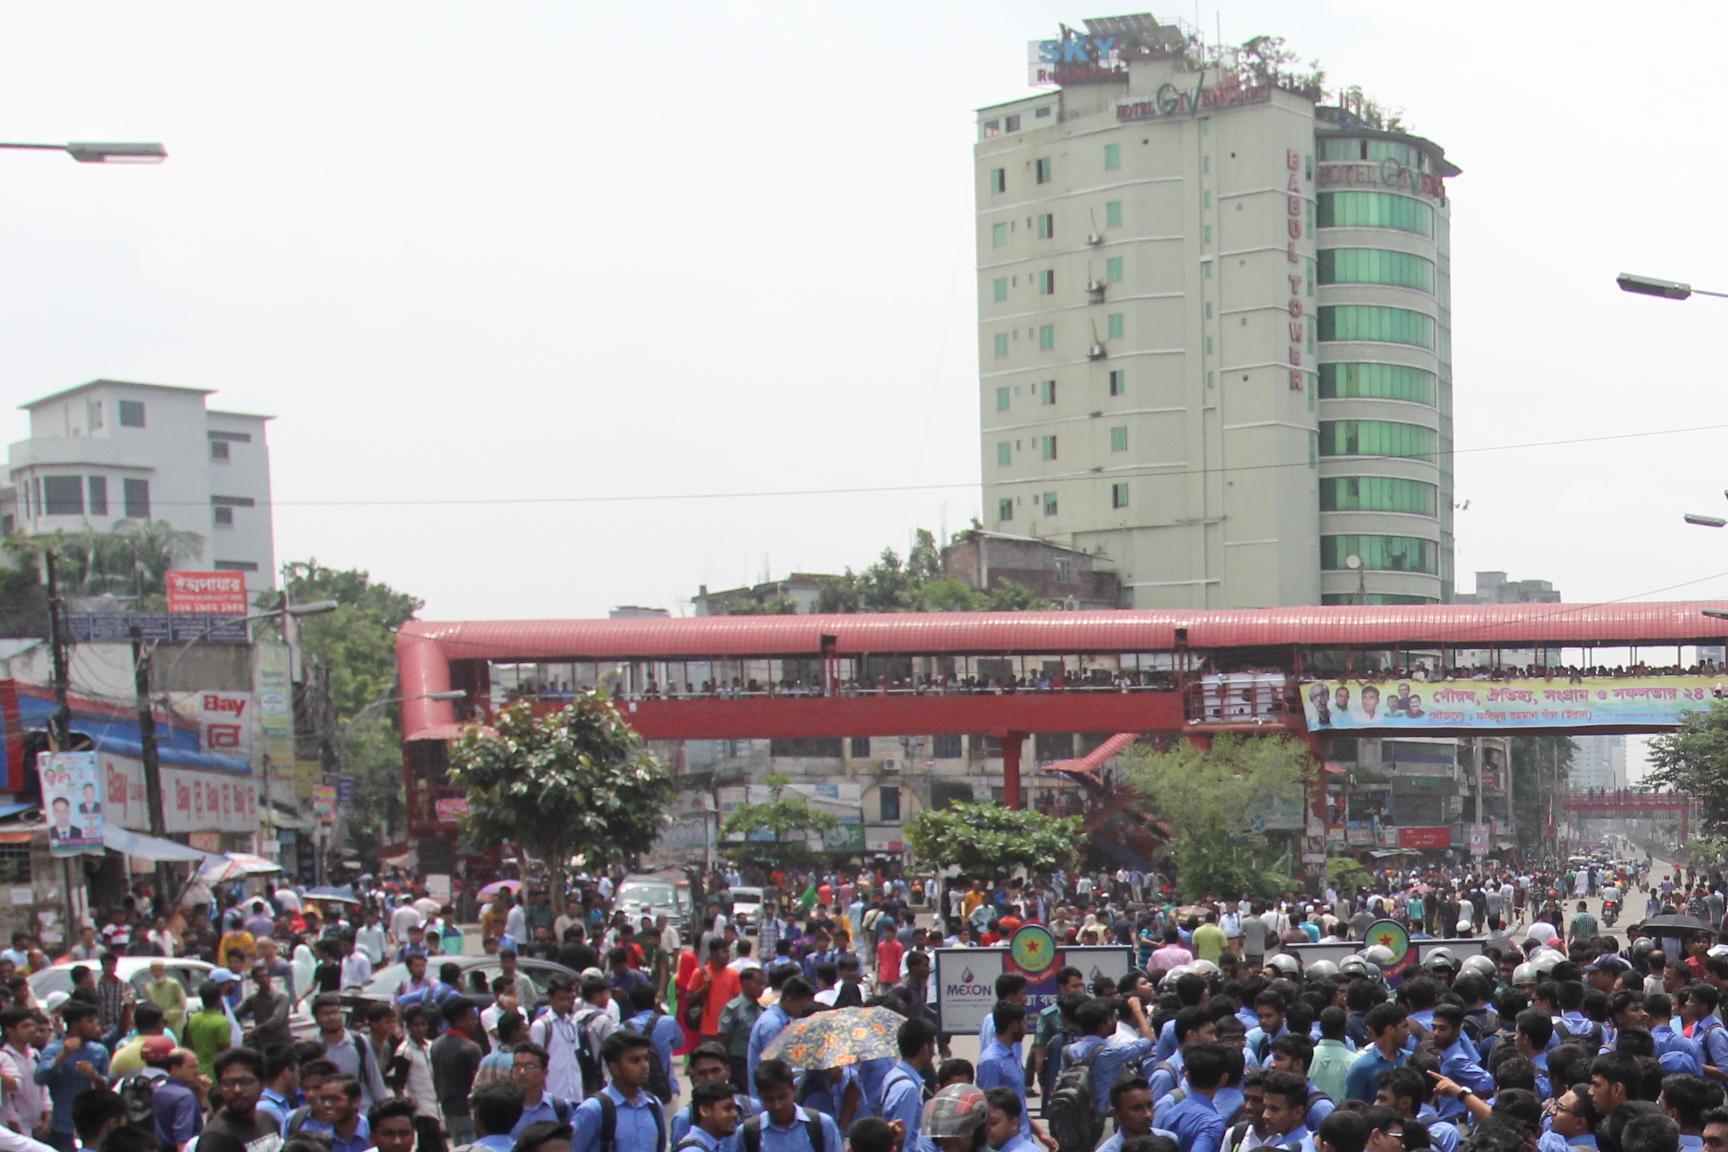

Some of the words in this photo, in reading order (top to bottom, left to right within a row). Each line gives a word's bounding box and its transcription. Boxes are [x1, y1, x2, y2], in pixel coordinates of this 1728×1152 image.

[1040, 37, 1116, 62] SKY
[1319, 164, 1377, 187] HOTEL
[1287, 149, 1301, 263] BABUL
[1288, 275, 1303, 391] TOWER
[203, 695, 245, 717] Bay
[947, 984, 992, 996] MEXON
